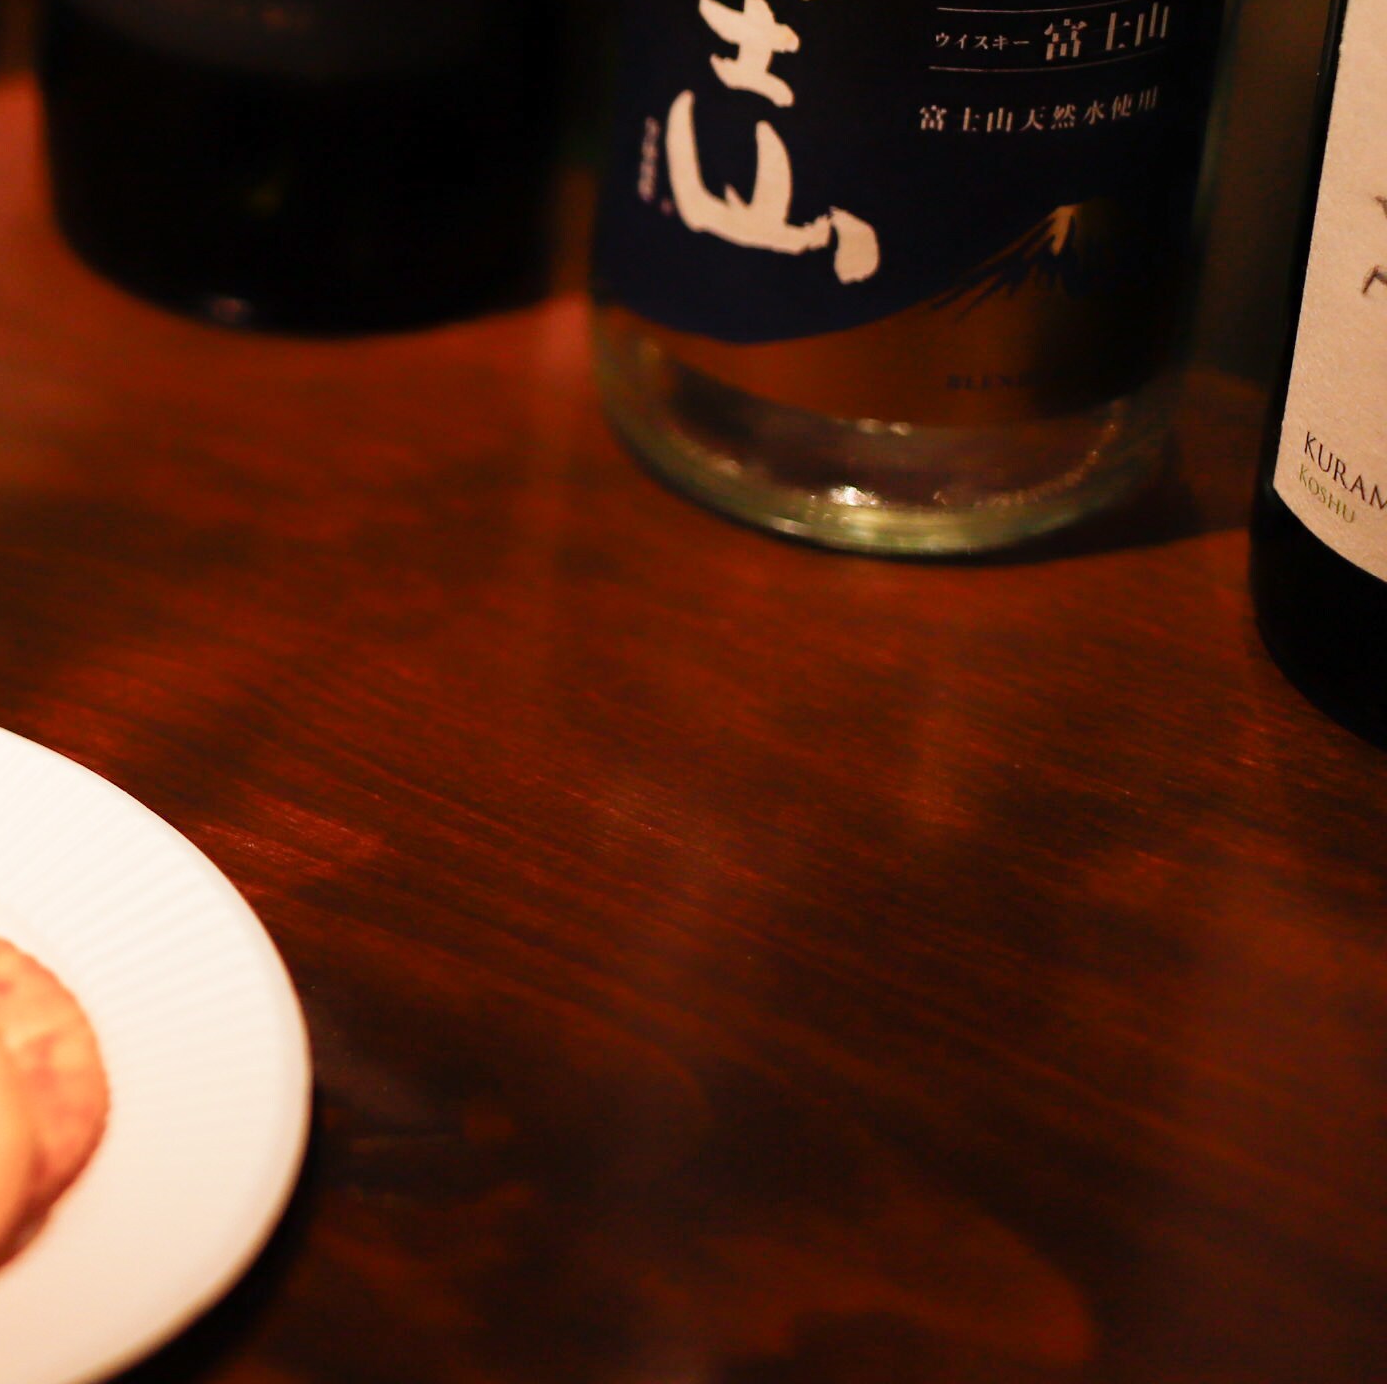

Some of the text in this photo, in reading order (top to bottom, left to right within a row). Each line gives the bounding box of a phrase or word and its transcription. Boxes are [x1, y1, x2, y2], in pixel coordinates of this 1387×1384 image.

[934, 1, 1172, 62] ウイスキー 富士山
[1299, 463, 1356, 524] KOSHU
